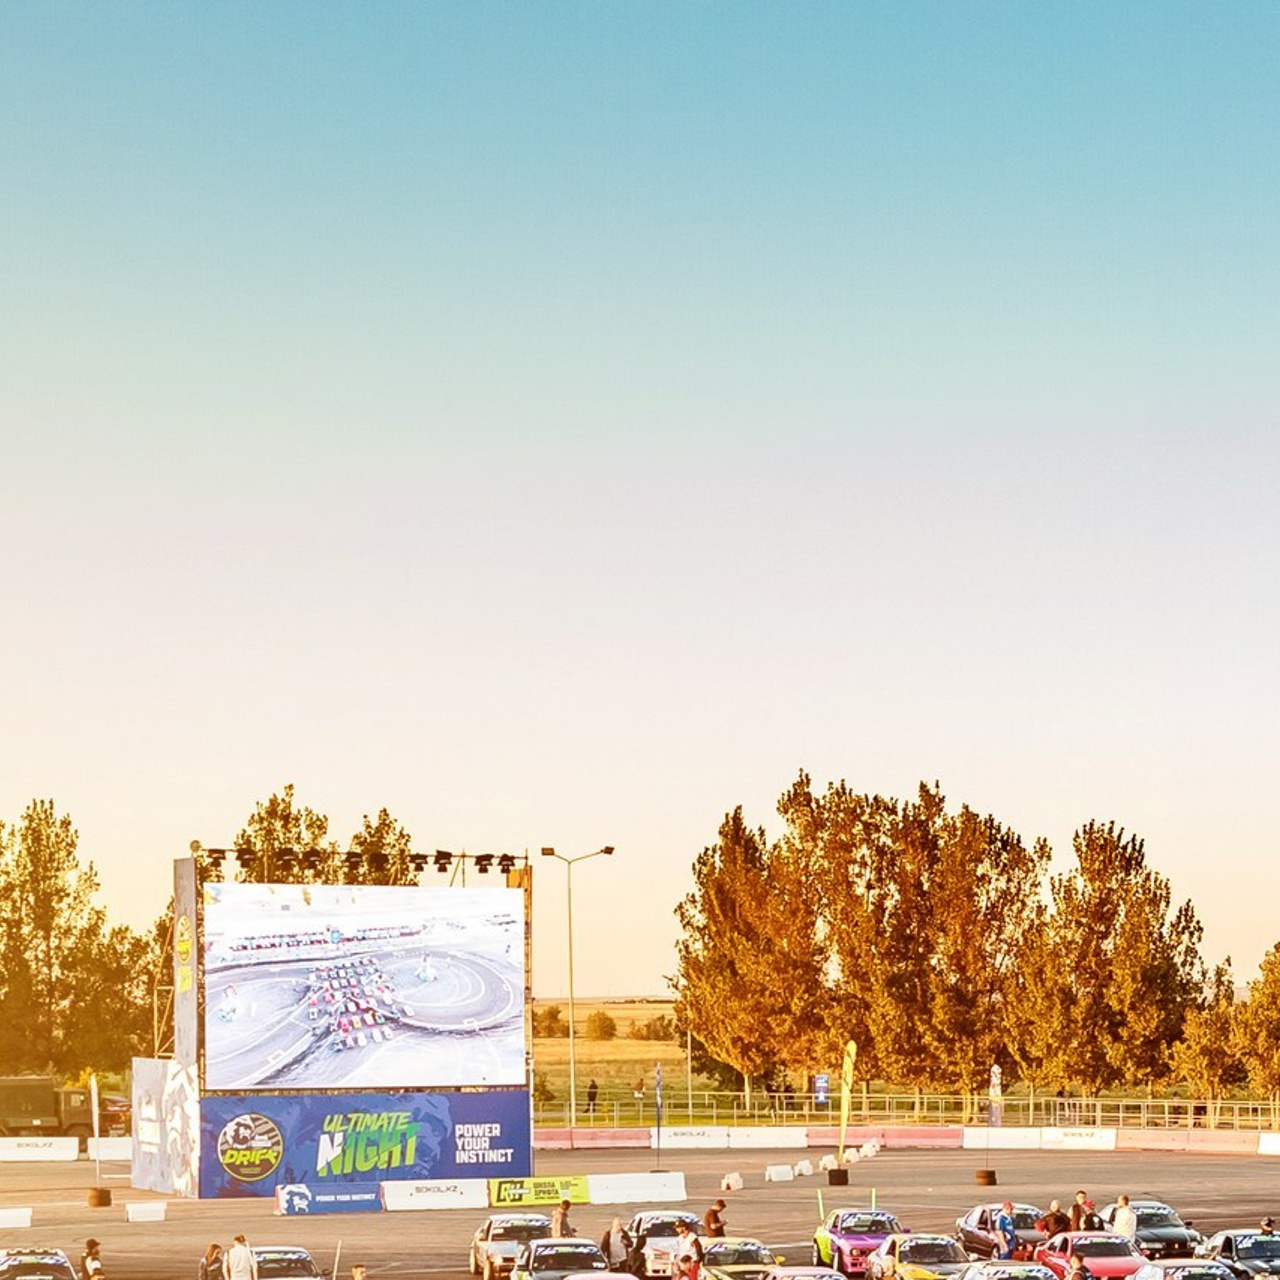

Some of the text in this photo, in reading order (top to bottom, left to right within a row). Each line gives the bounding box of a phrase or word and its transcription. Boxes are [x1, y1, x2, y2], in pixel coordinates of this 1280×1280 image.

[322, 1111, 412, 1132] ULTIMATE
[455, 1123, 501, 1138] POWER
[316, 1122, 422, 1177] NIGHT
[455, 1137, 496, 1151] YOUR
[455, 1149, 515, 1164] INSTINCT
